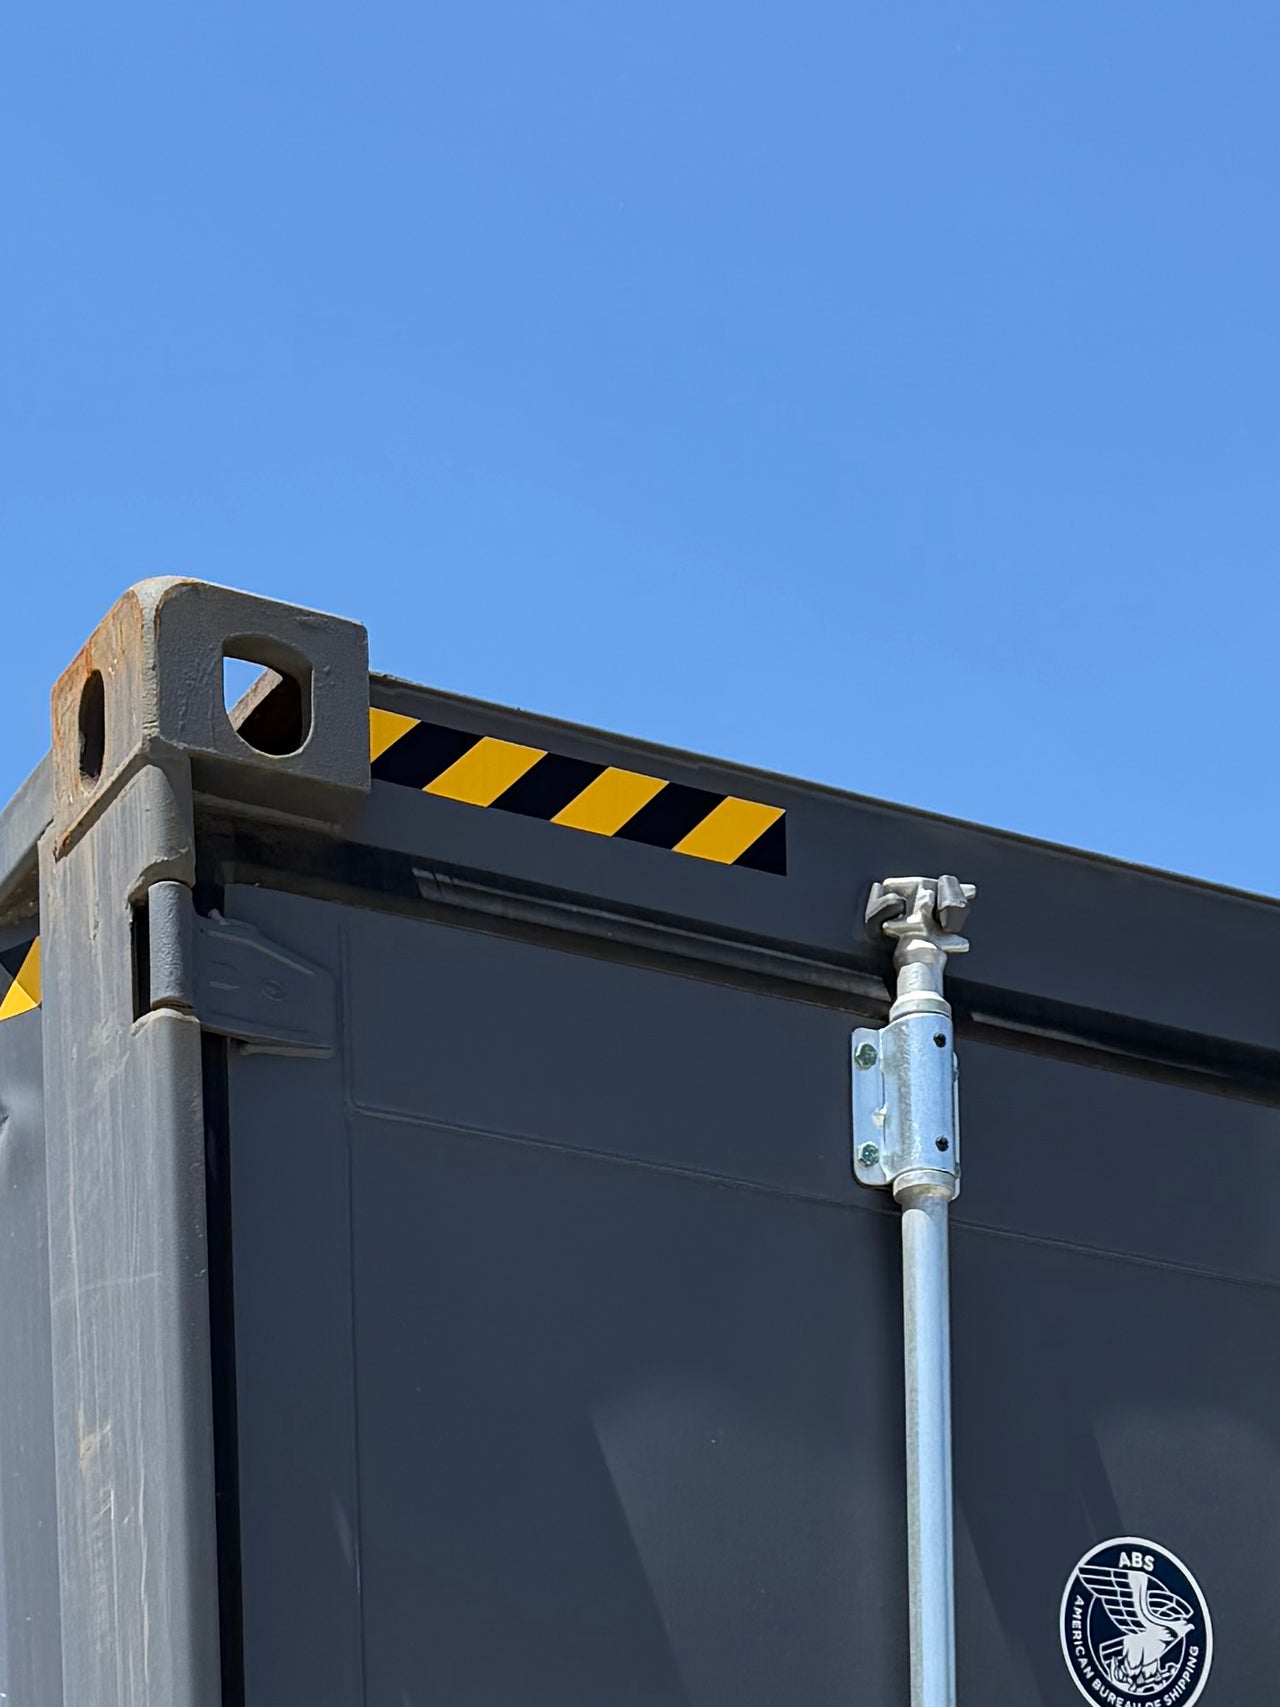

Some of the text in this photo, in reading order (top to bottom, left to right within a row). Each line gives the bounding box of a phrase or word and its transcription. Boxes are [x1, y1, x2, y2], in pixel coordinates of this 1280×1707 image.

[1118, 1551, 1155, 1572] ABS
[1071, 1594, 1093, 1679] AMERICAN
[1164, 1645, 1200, 1707] SHIPPING
